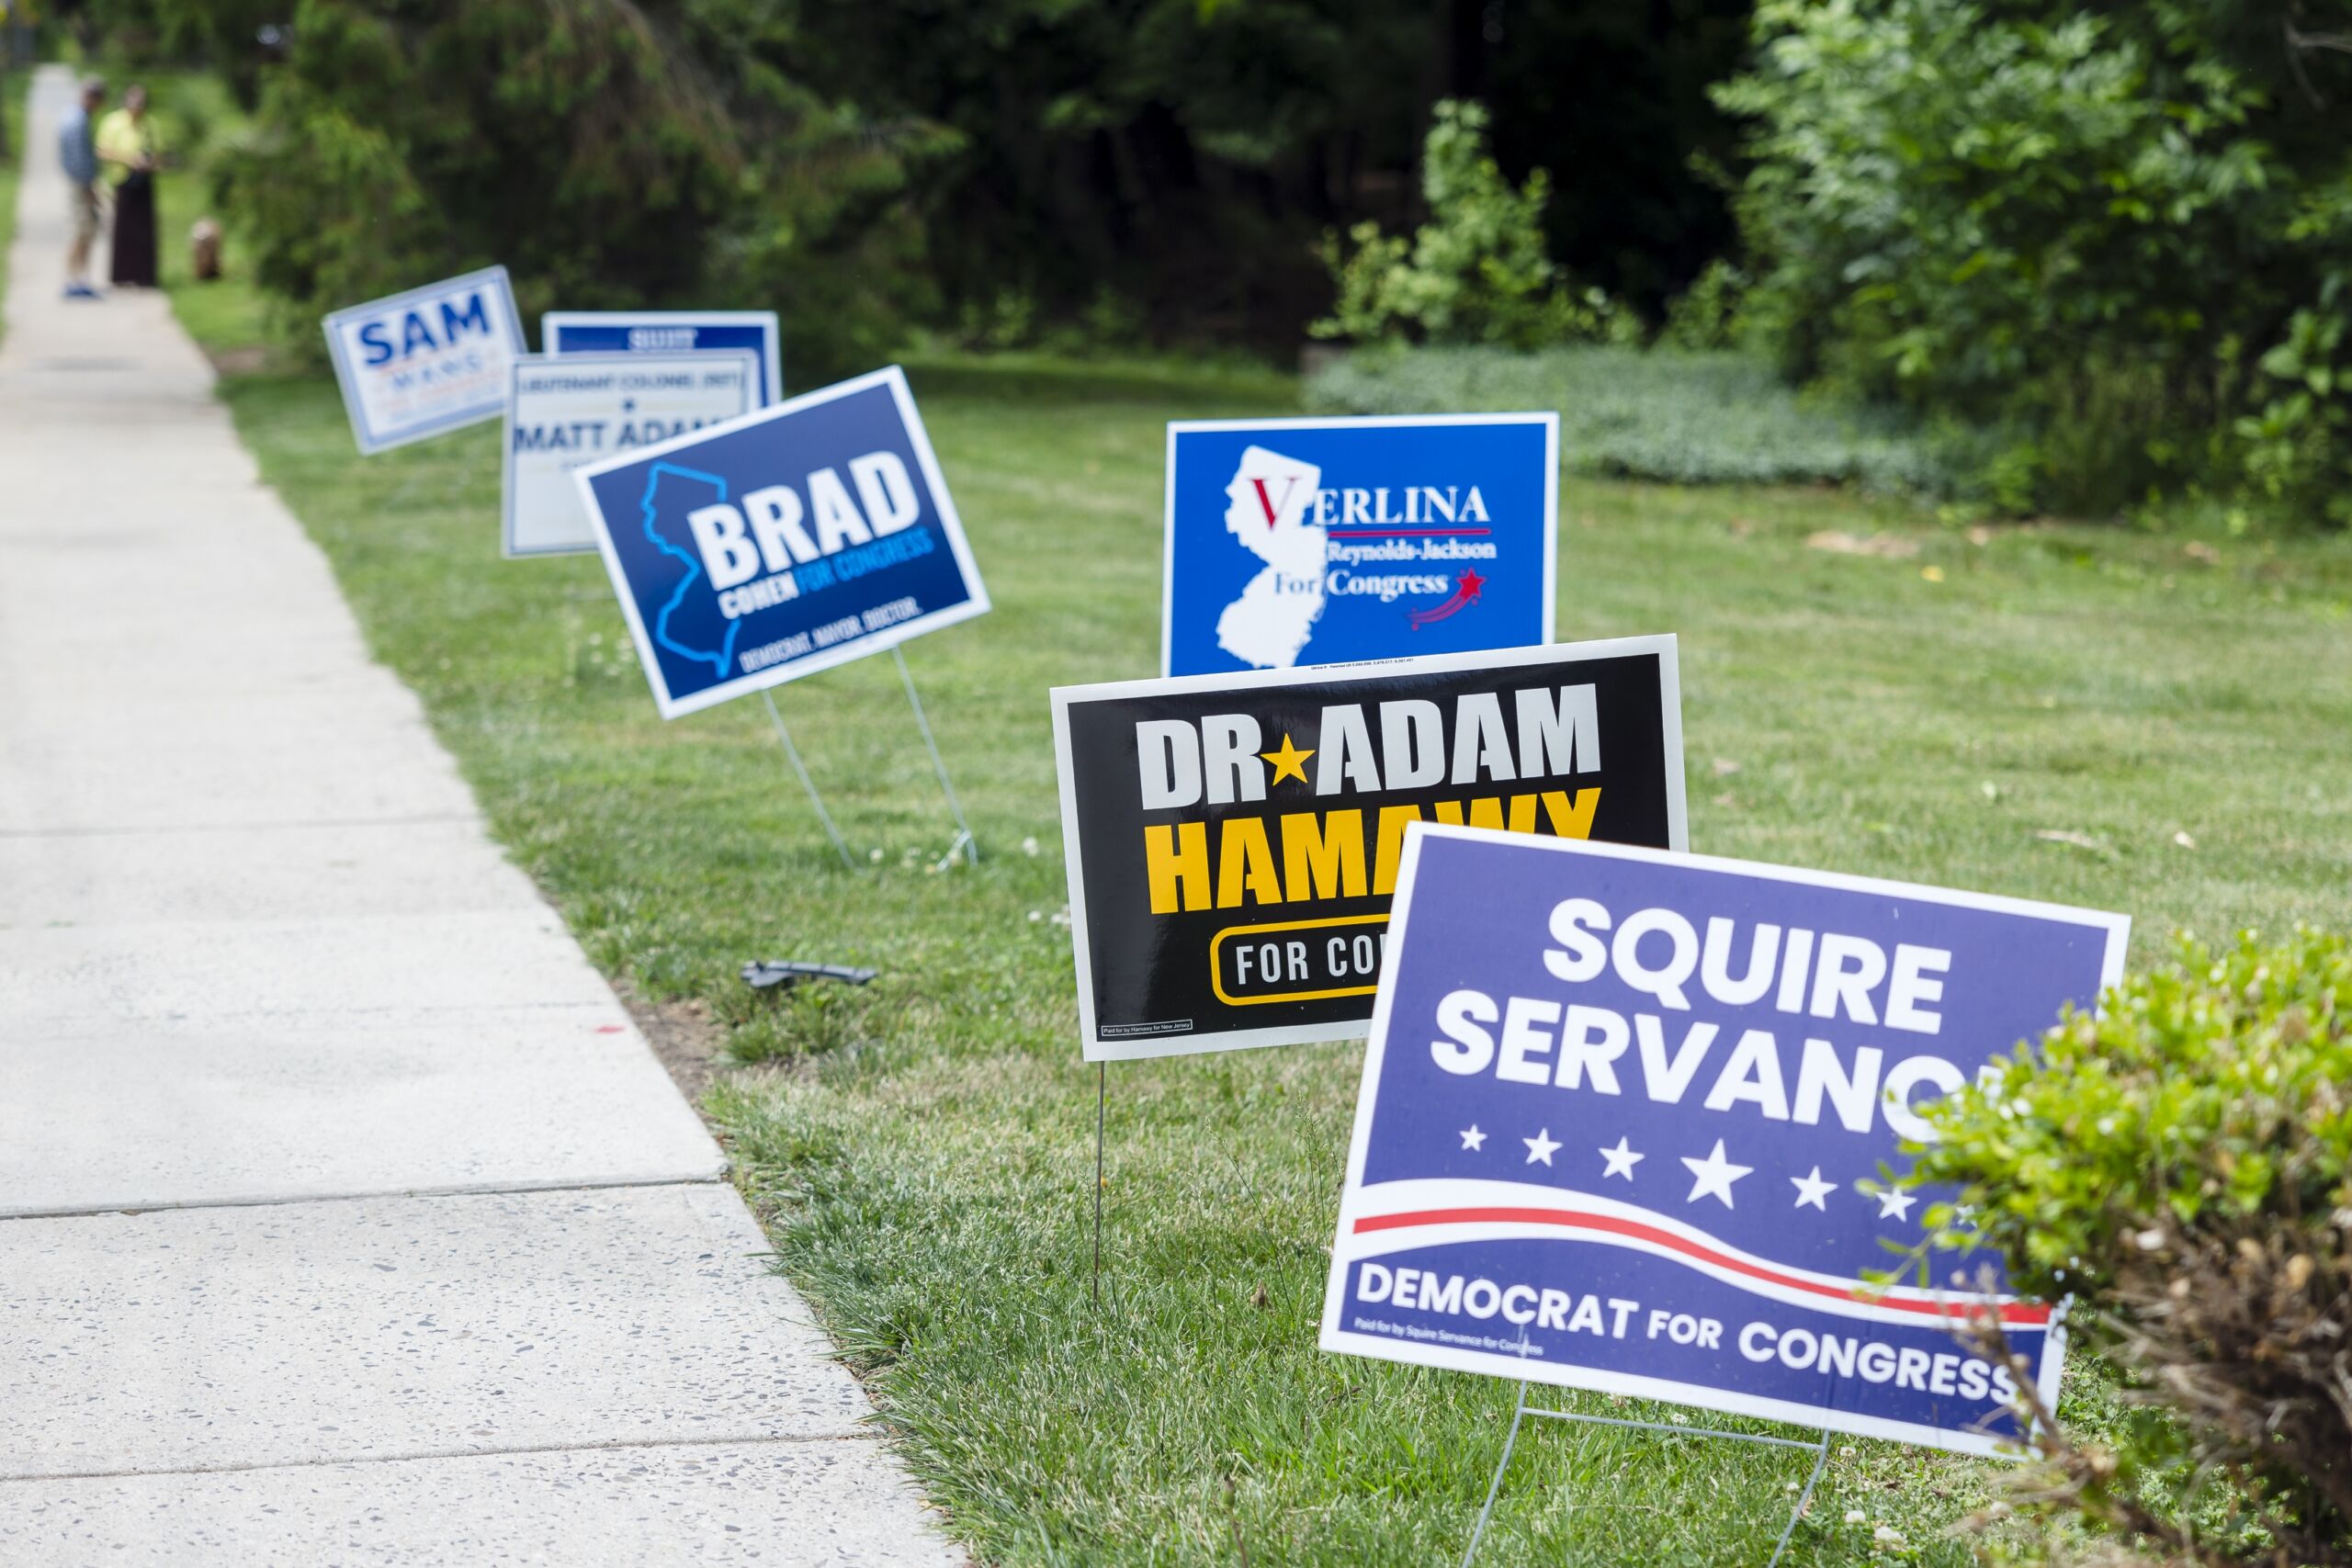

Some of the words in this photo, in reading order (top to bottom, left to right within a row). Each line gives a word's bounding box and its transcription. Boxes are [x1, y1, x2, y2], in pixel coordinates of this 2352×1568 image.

[359, 294, 491, 366] SAM
[514, 421, 608, 452] MATT
[687, 450, 921, 592] BRAD
[1249, 478, 1491, 530] VERLINA
[718, 571, 799, 619] COHEN
[795, 558, 837, 595] FOR
[833, 526, 935, 581] CONGRESS
[1329, 537, 1496, 566] Reynolds-Jackson
[1274, 573, 1317, 595] For
[1328, 571, 1449, 602] Congress
[1136, 714, 1267, 810] DR
[1316, 682, 1600, 796] ADAM
[1237, 940, 1308, 986] FOR
[1544, 897, 1951, 1034] SQUIRE
[1131, 1025, 1152, 1033] Hamawy
[1430, 990, 2005, 1144] SERVANC
[1354, 1317, 1375, 1331] Paid
[1376, 1319, 1391, 1333] for
[1393, 1323, 1406, 1337] by
[1407, 1325, 1438, 1340] Squire
[1439, 1329, 1482, 1348] Servance
[1483, 1336, 1498, 1348] for
[1356, 1264, 1640, 1339] DEMOCRAT
[1648, 1310, 1722, 1351] FOR
[1739, 1323, 2019, 1407] CONGRESS
